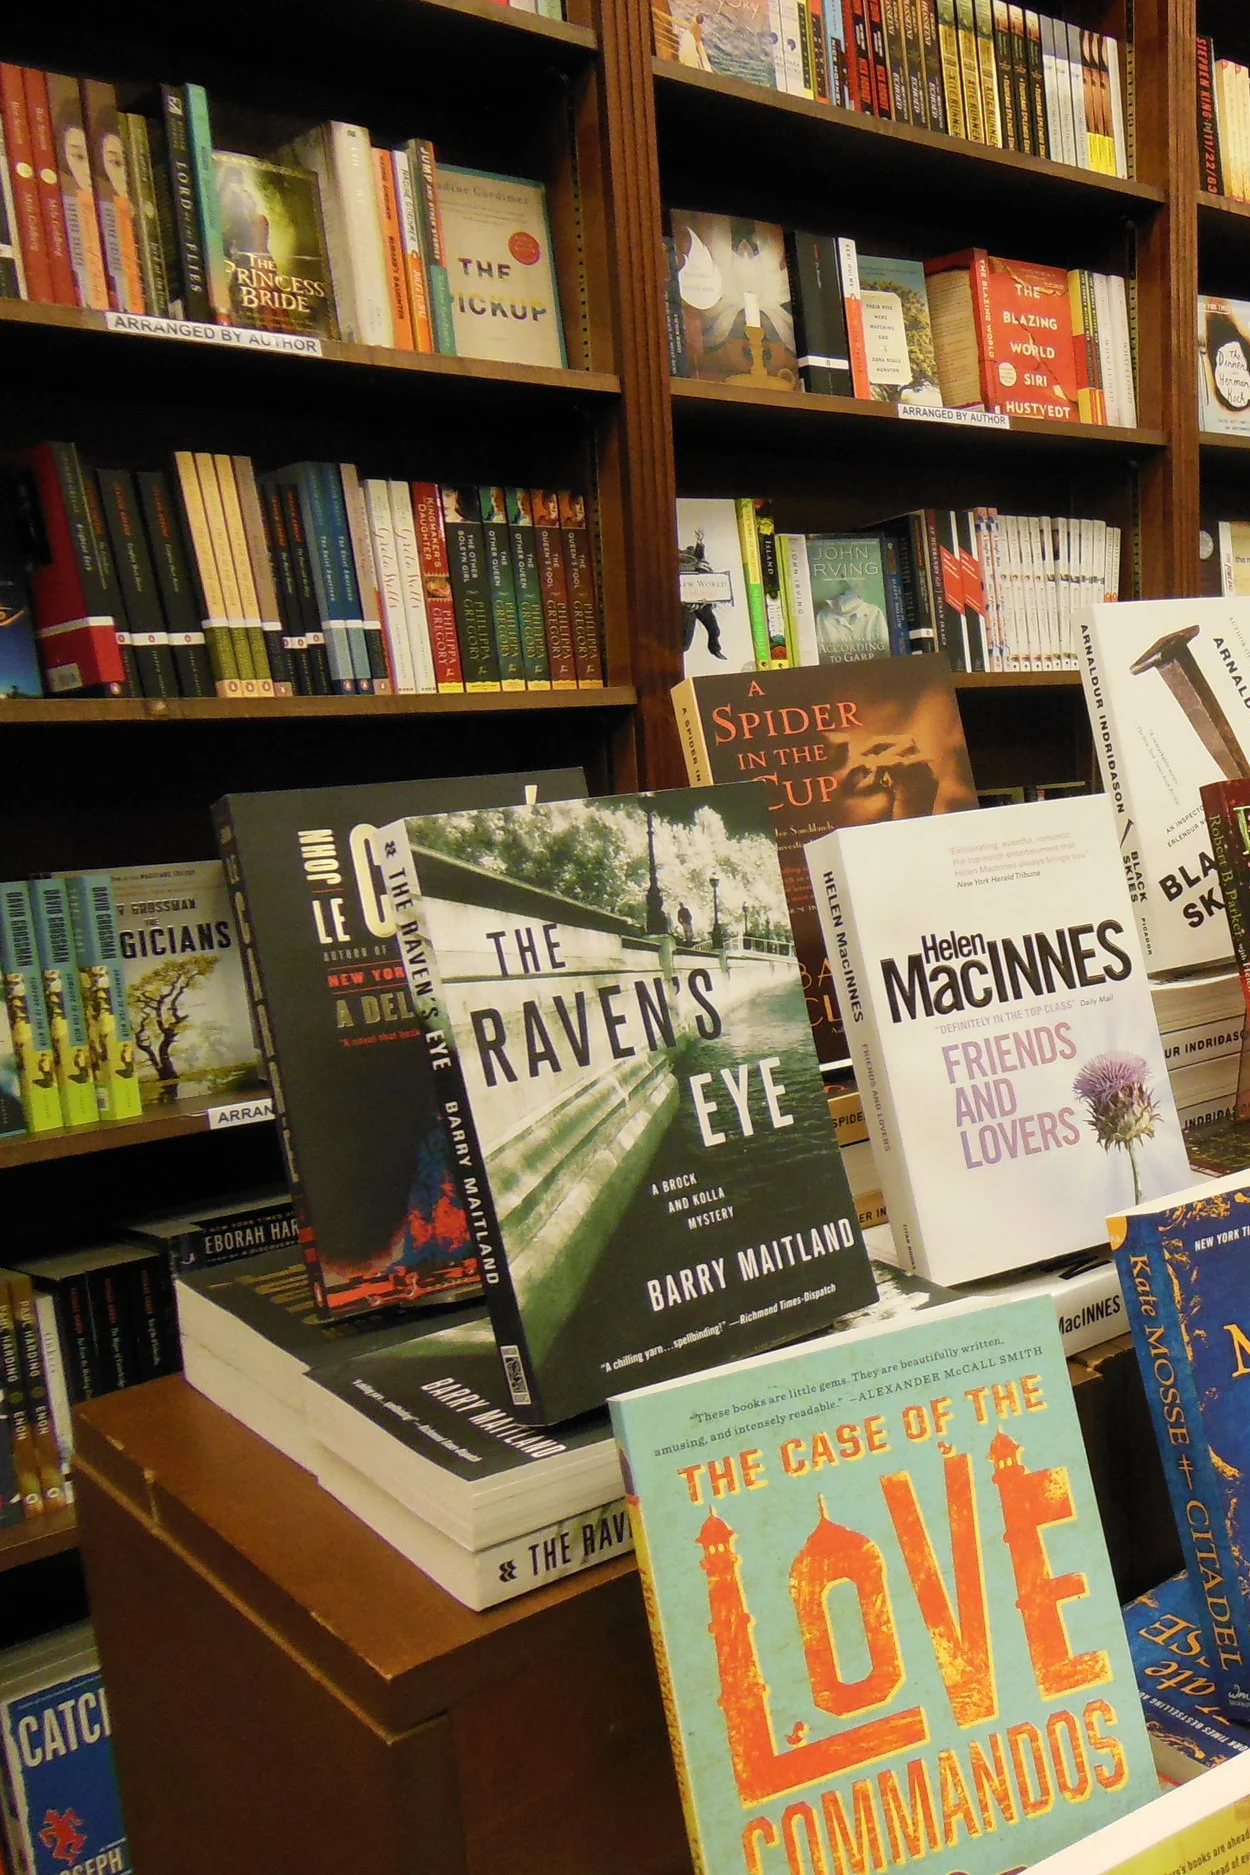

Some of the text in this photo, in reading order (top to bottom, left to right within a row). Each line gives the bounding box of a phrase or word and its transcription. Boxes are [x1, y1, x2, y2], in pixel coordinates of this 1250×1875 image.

[248, 253, 276, 270] THE
[458, 258, 511, 279] THE
[240, 287, 310, 312] BRIDE
[1015, 284, 1040, 298] THE
[451, 295, 547, 321] ICKUP
[1003, 311, 1058, 330] BLAZING
[115, 316, 316, 352] ARRANGED BY AUTHOR
[1010, 342, 1055, 359] WORLD
[1024, 374, 1047, 387] SIRI
[902, 407, 1006, 424] ARRANGED BY AUTHOR
[1006, 402, 1070, 419] HUSTVEDT
[417, 503, 432, 560] DAUGHTER
[765, 540, 774, 575] ISLAND
[814, 547, 868, 560] JOHN
[433, 608, 447, 665] GREGORY
[747, 680, 765, 698] A
[711, 701, 863, 745] SPIDER
[1080, 624, 1126, 816] ARNALDUR INDRIDASON
[736, 744, 828, 771] IN THE
[957, 870, 1041, 888] New York Herald Tribune
[119, 920, 232, 959] GICIANS
[486, 924, 567, 977] THE
[921, 932, 987, 962] Helen
[878, 917, 1134, 1026] MacINNES
[468, 968, 724, 1090] RAVEN'S
[940, 1021, 1079, 1085] FRIENDS
[688, 1055, 796, 1148] EYE
[954, 1076, 1019, 1128] AND
[959, 1108, 1082, 1170] LOVERS
[651, 1172, 698, 1196] A BROCK
[667, 1186, 726, 1213] AND KOLLA
[687, 1205, 735, 1231] MYSTERY
[1194, 1239, 1215, 1251] NEW
[1217, 1229, 1240, 1245] YORK
[646, 1216, 856, 1313] BARRY MAITLAND
[34, 1405, 49, 1436] ENON
[678, 1374, 1049, 1507] THE CASE OF THE
[695, 1428, 1114, 1810] LOVE
[740, 1697, 1130, 1875] COMMANDOS
